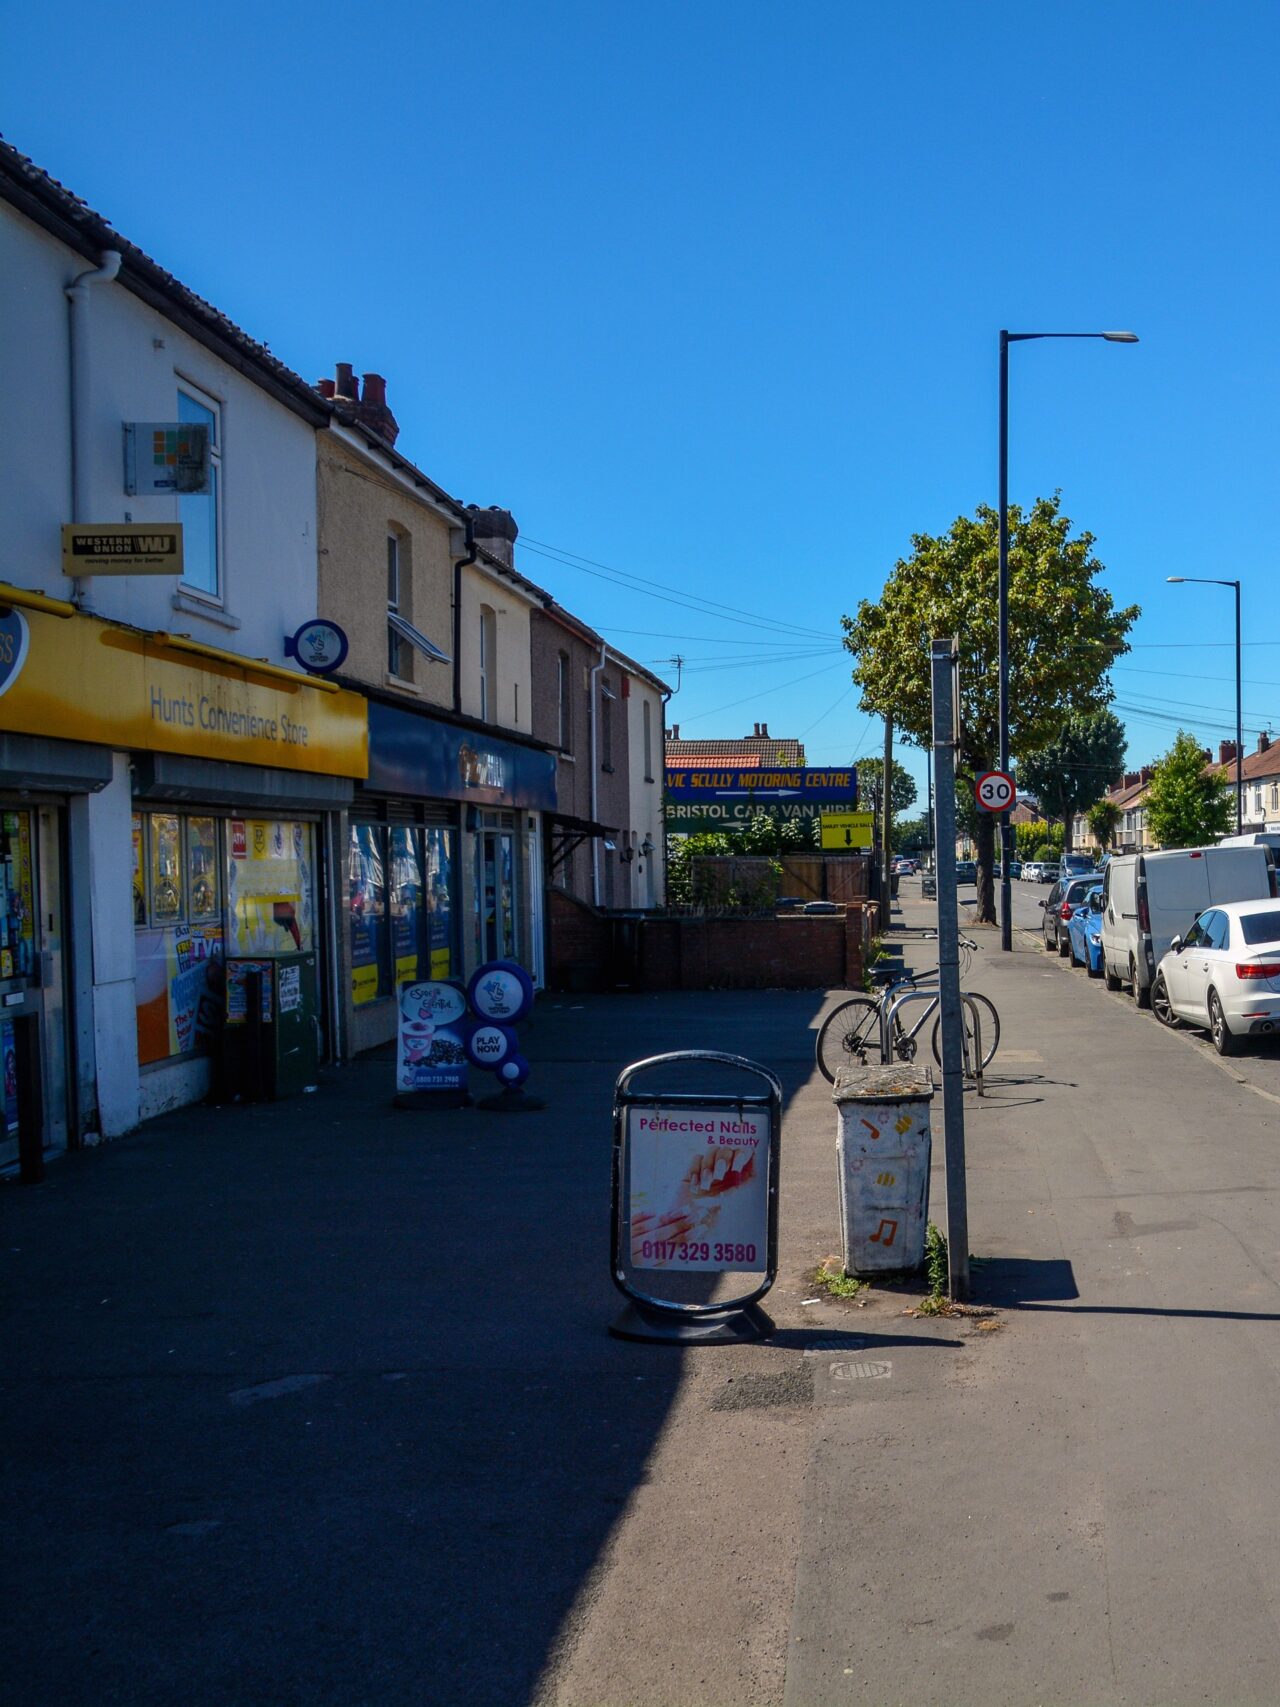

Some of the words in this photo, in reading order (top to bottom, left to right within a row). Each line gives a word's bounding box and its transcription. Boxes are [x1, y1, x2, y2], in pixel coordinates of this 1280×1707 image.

[76, 536, 132, 546] WESTERN
[137, 536, 171, 553] WU
[94, 545, 132, 553] UNION
[84, 557, 109, 565] moving
[135, 556, 144, 564] for
[150, 684, 195, 726] Hunts
[199, 696, 278, 741] Convenience
[280, 714, 309, 747] Store
[667, 773, 687, 788] VIC
[690, 772, 734, 788] SCULLY
[737, 772, 802, 788] MOTORING
[805, 772, 853, 787] CENTRE
[982, 783, 1010, 800] 30
[666, 804, 730, 819] BRISTOL
[733, 804, 767, 818] CAR
[768, 805, 780, 818] &
[781, 804, 815, 818] VAN
[818, 804, 854, 813] HIRE
[233, 831, 246, 845] ATM
[476, 1036, 500, 1045] PLAY
[477, 1045, 501, 1053] NOW
[640, 1118, 715, 1138] Perfected
[719, 1120, 758, 1138] Nails
[707, 1135, 715, 1147] &
[718, 1135, 760, 1150] Beauty
[642, 1240, 677, 1262] 0117
[678, 1241, 710, 1263] 329
[713, 1242, 757, 1264] 3580
